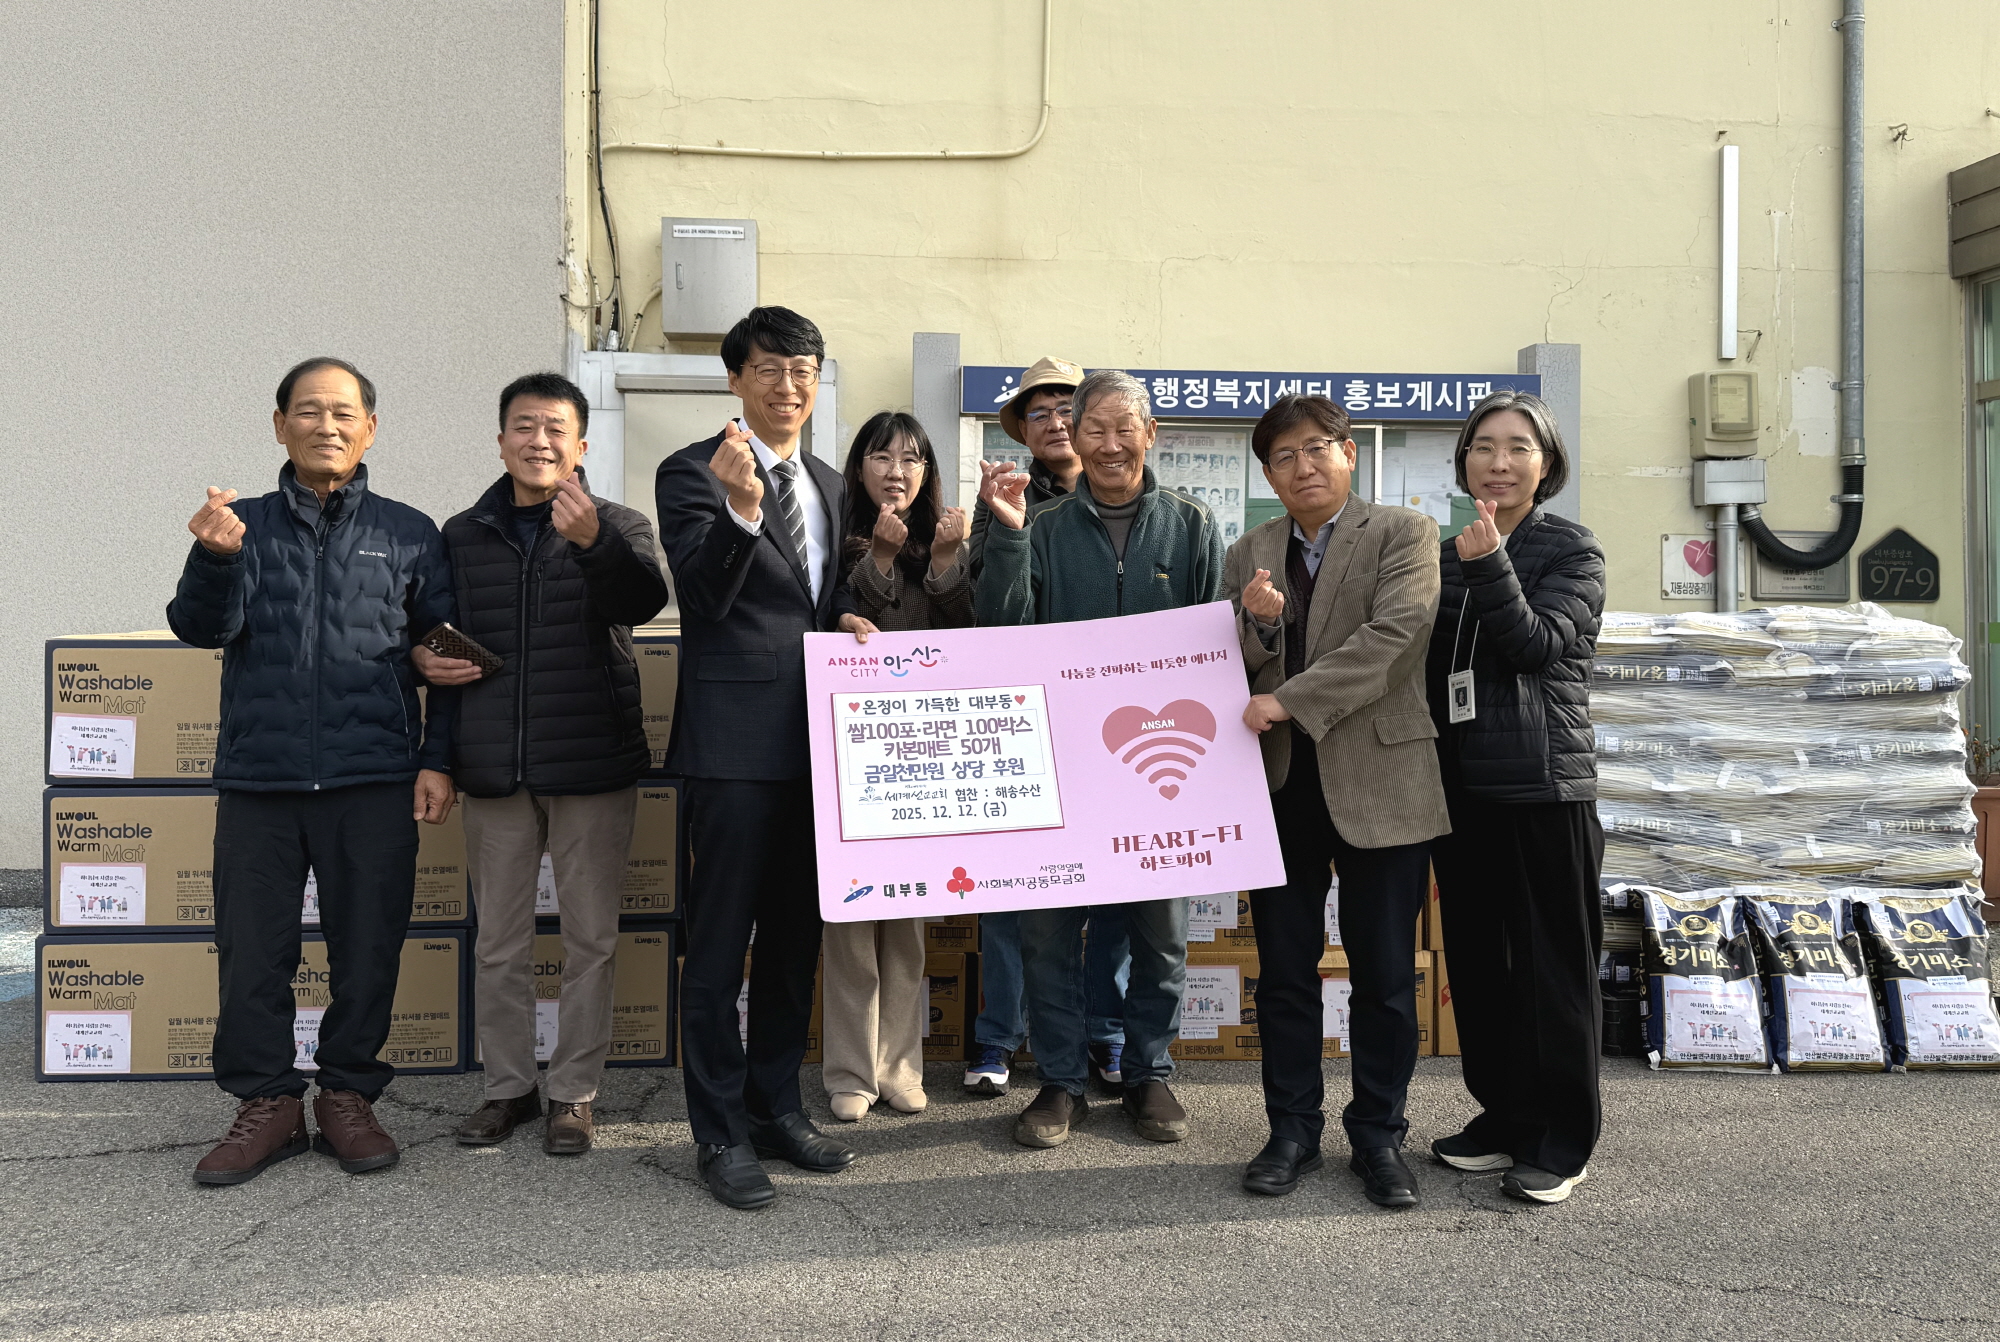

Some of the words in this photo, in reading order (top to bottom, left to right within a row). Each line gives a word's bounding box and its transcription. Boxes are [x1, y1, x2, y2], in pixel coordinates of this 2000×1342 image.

[1343, 379, 1493, 412] 홍보게시판
[1870, 566, 1935, 597] 97-9
[828, 656, 879, 666] ANSAN
[1060, 666, 1096, 680] 나눔을
[1099, 662, 1148, 677] 전파하는
[1190, 649, 1228, 665] 에너지
[58, 674, 154, 691] Washable
[850, 668, 879, 678] CITY
[58, 690, 102, 704] Warm
[104, 696, 146, 714] Mat
[862, 698, 906, 716] 온정이
[915, 696, 960, 714] 가득한
[968, 694, 1013, 710] 대부동
[965, 716, 1034, 737] 100박스
[1140, 718, 1176, 731] ANSAN
[884, 740, 954, 761] 카본매트
[960, 736, 1002, 756] 50개
[952, 759, 986, 780] 상당
[992, 758, 1026, 776] 후원
[954, 787, 979, 802] 협찬
[994, 784, 1042, 799] 해송수산
[892, 808, 927, 821] 2025.
[932, 806, 952, 819] 12.
[958, 804, 978, 818] 12.
[983, 802, 1008, 818] (금)
[56, 823, 153, 840] Washable
[1111, 824, 1244, 854] HEART-FI
[57, 840, 100, 852] Warm
[102, 844, 146, 862] Mat
[1138, 850, 1212, 872] 하트파이
[883, 882, 928, 899] 대부동
[976, 872, 1086, 890] 사회복지공동모금회
[1659, 945, 1732, 970] 경기미소
[1890, 950, 1973, 972] 경기미소
[48, 970, 145, 987] Washable
[48, 987, 92, 1000] Warm
[94, 992, 137, 1010] Mat
